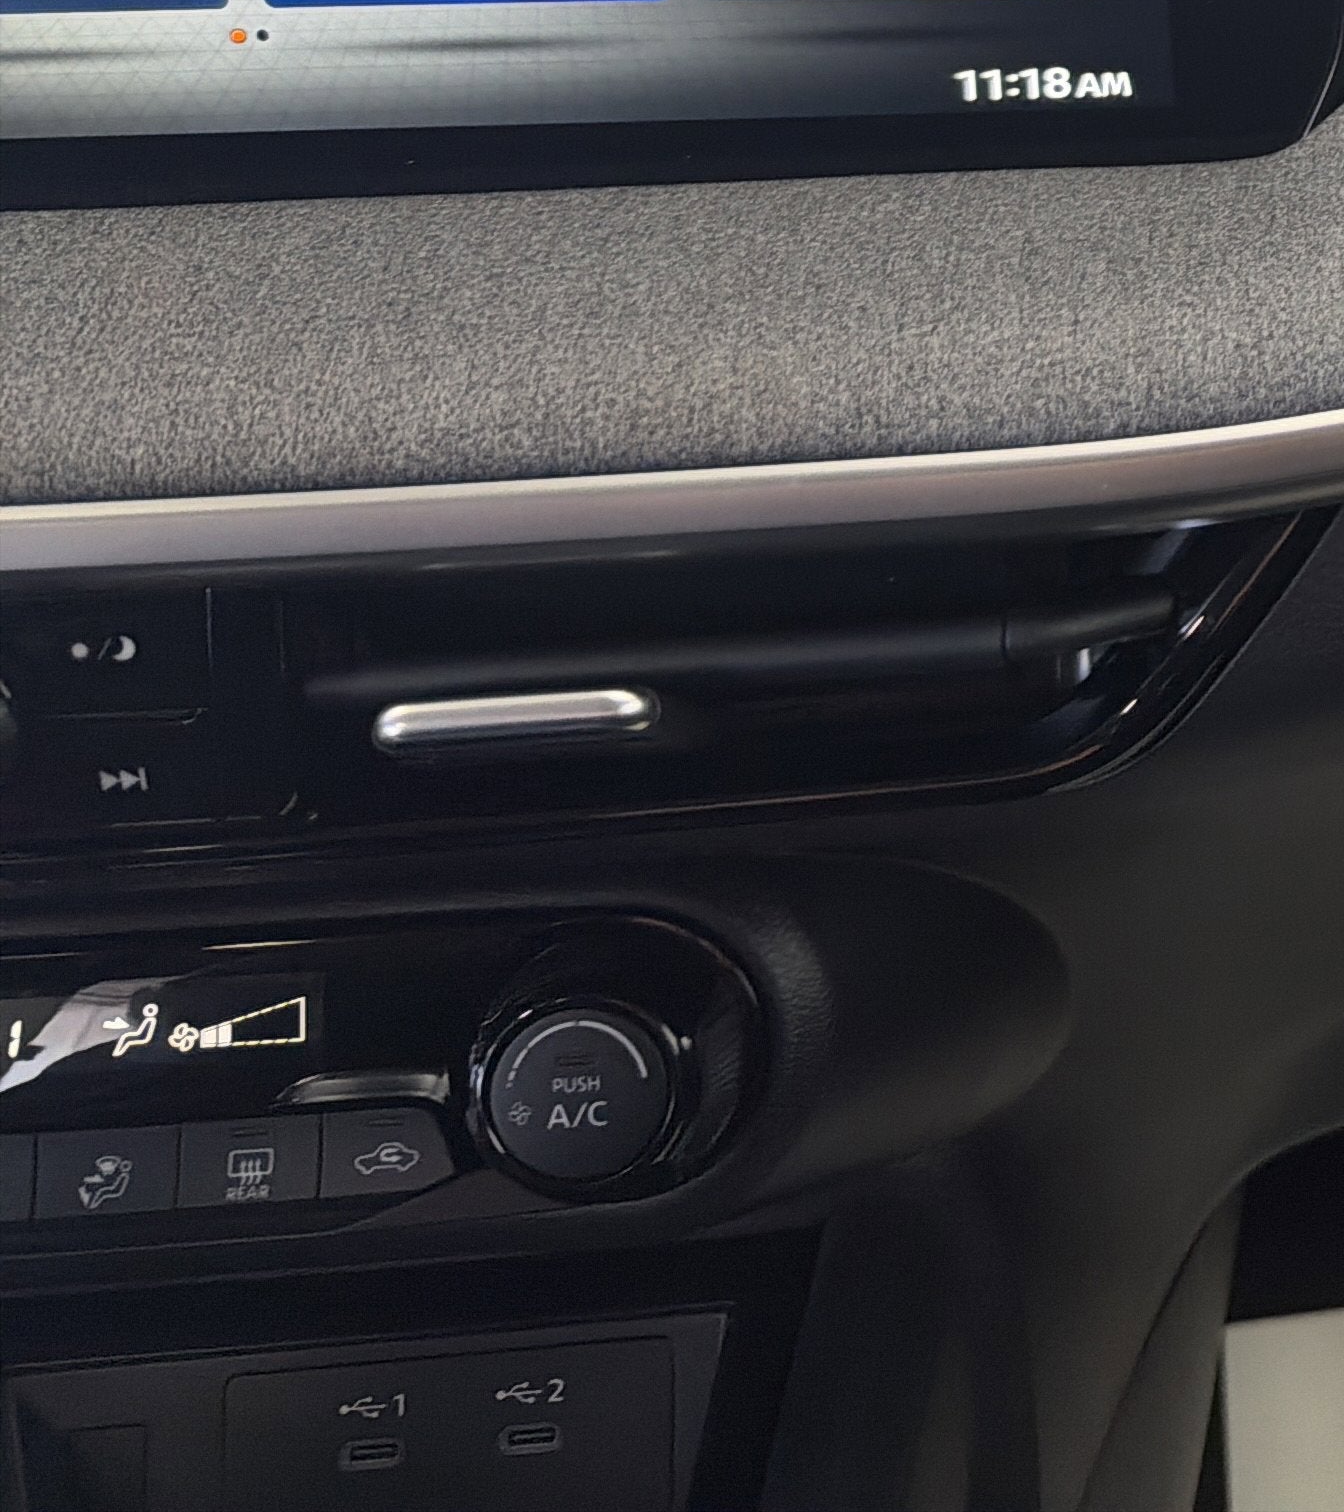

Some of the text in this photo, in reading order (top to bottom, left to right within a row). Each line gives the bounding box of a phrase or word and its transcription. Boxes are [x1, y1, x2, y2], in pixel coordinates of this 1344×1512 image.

[551, 1075, 601, 1094] PUSH
[547, 1100, 609, 1130] A/C
[225, 1185, 270, 1201] REAR
[547, 1378, 565, 1402] 2
[392, 1393, 405, 1416] 1
